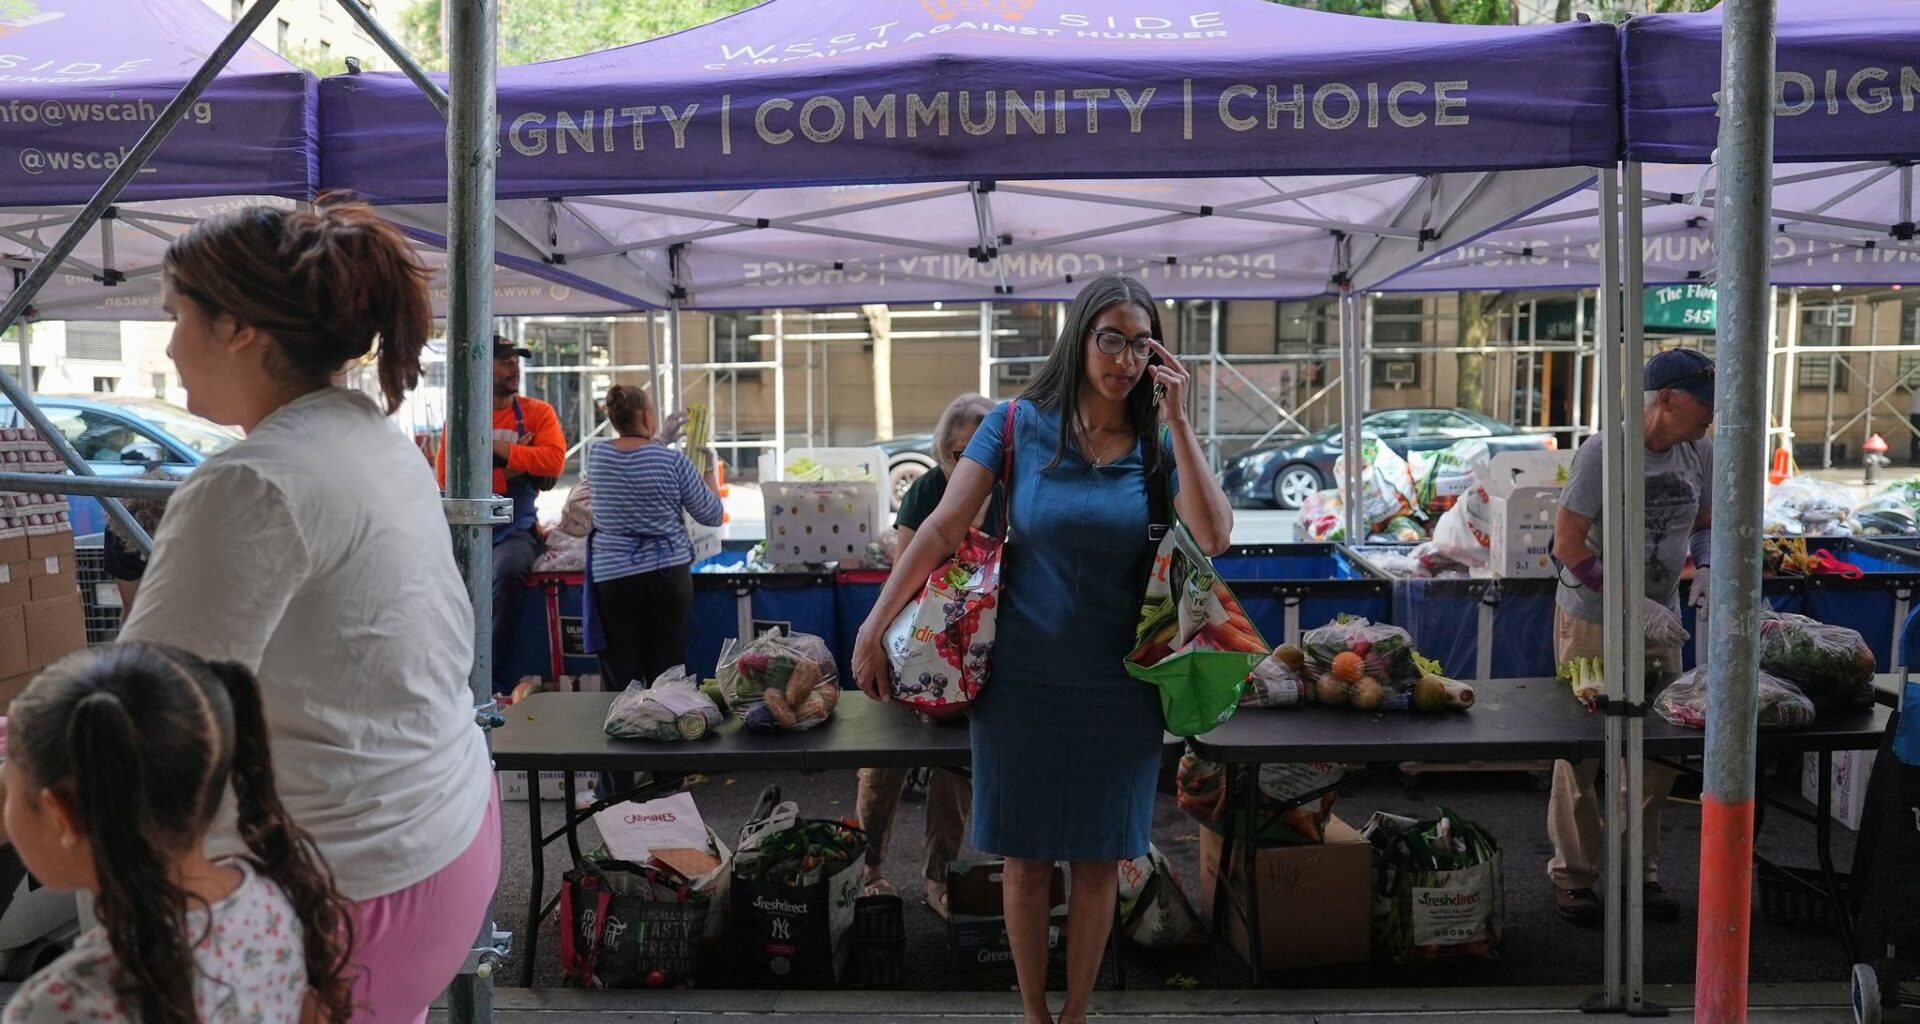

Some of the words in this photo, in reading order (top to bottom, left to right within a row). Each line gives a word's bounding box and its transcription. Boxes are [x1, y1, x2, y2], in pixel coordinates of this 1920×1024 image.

[1059, 11, 1225, 29] SIDE
[903, 21, 1061, 42] AGAINST
[1077, 30, 1230, 39] HUNGER
[496, 104, 700, 157] GNITY
[755, 87, 1157, 144] COMMUNITY
[1218, 80, 1470, 131] CHOICE
[1656, 287, 1683, 305] The
[1683, 309, 1712, 324] 545
[754, 896, 809, 914] freshdirect
[1421, 891, 1482, 908] freshdirect
